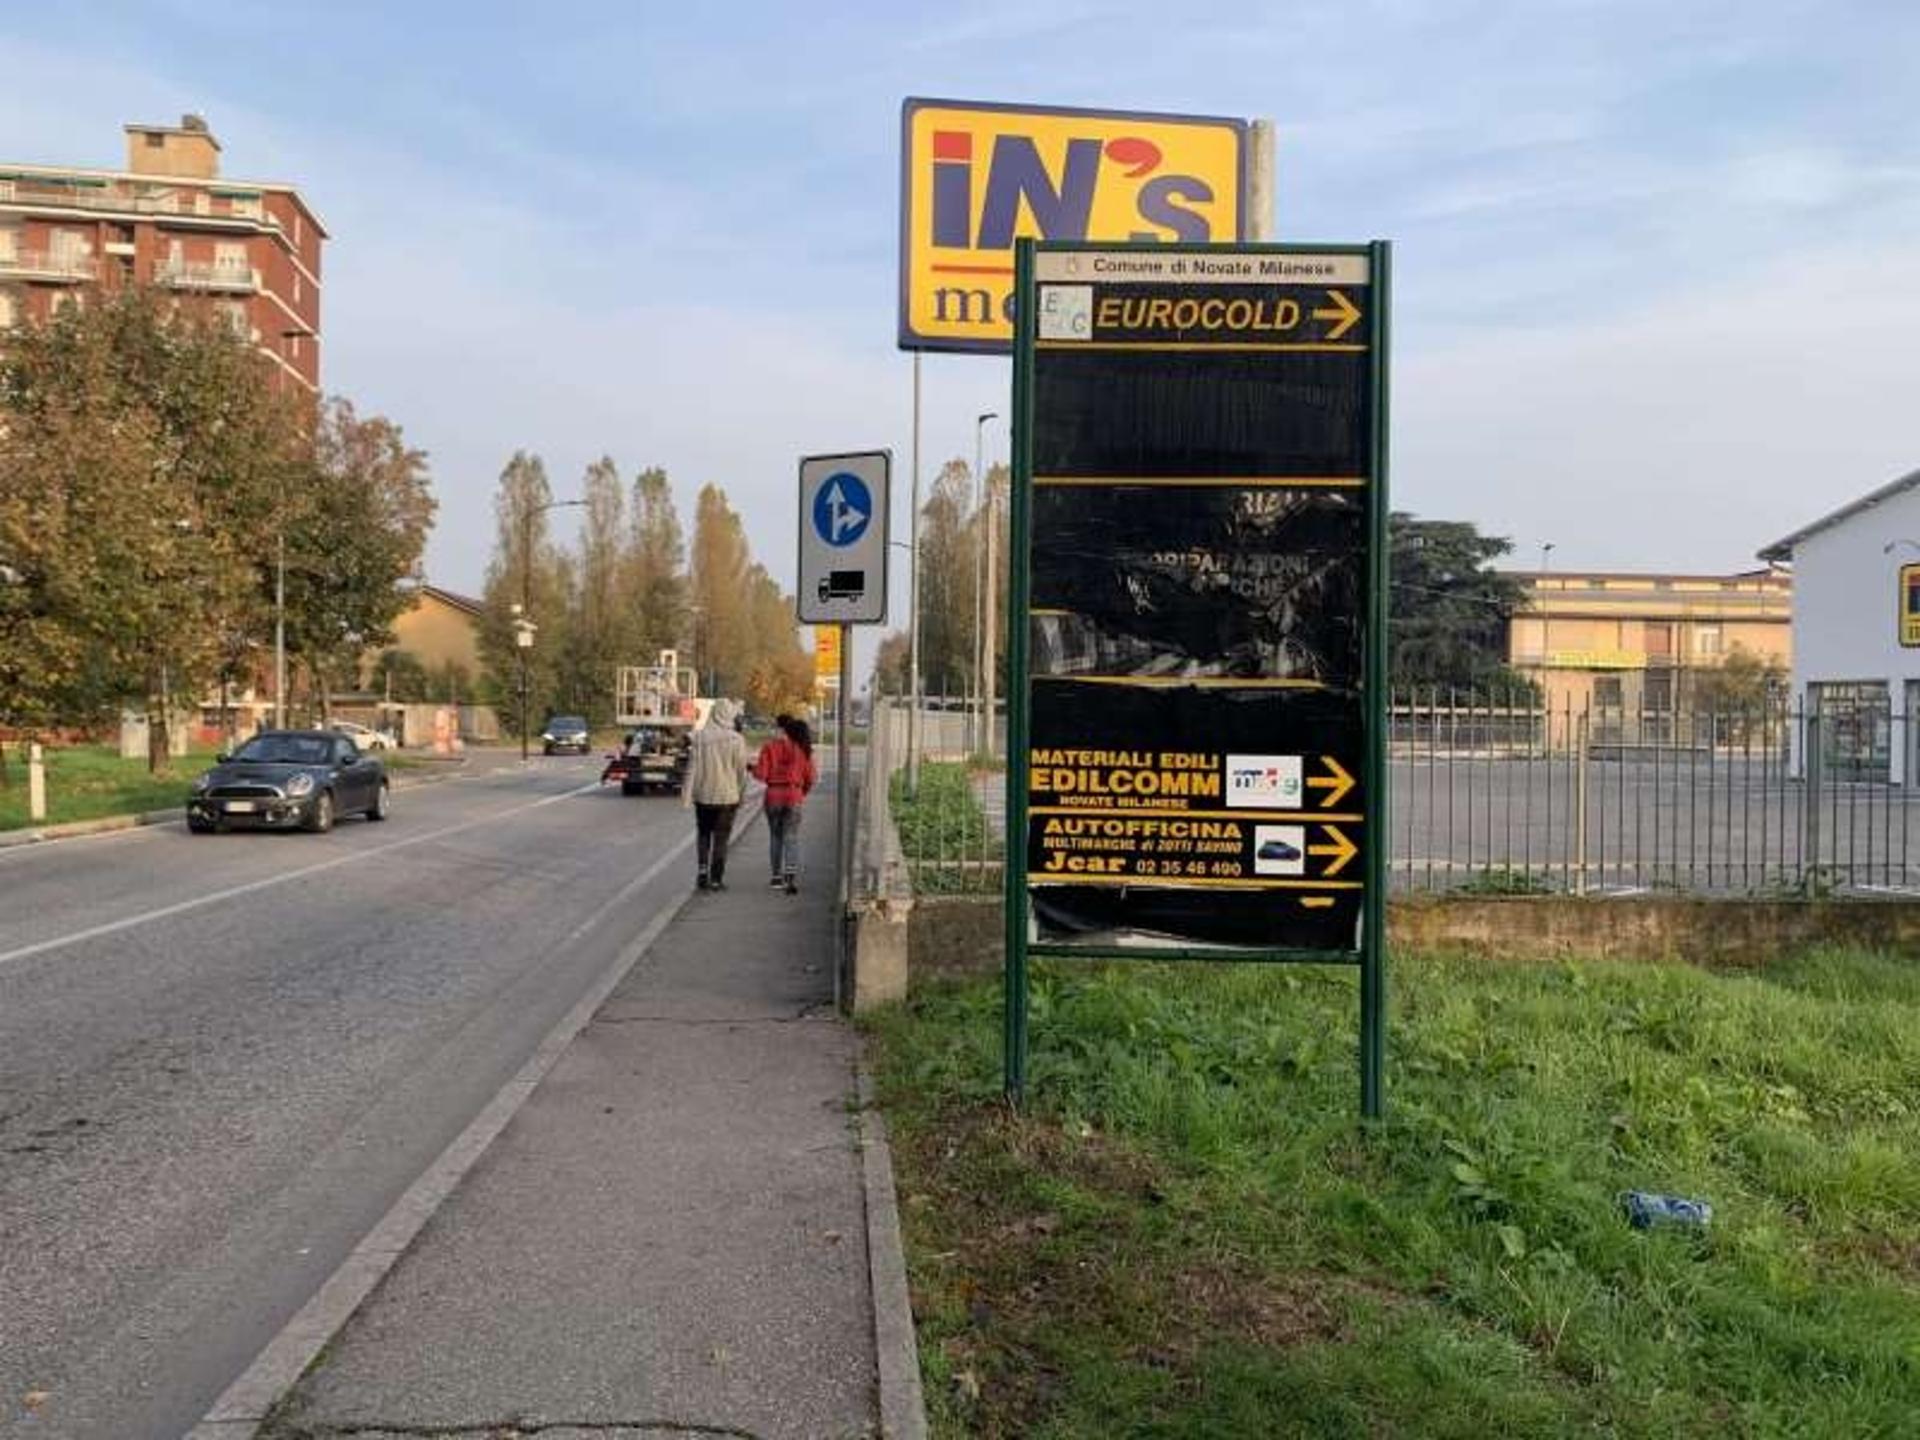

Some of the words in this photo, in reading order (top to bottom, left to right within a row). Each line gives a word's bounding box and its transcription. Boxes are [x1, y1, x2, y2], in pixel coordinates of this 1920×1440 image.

[1094, 258, 1163, 274] Comune
[1170, 258, 1188, 275] di
[1193, 260, 1253, 275] Novate
[1259, 260, 1336, 276] Milanese
[1096, 298, 1300, 331] EUROCOLD
[1031, 749, 1153, 768] MATERIALI
[1159, 753, 1220, 769] EDILI
[1030, 767, 1221, 796] EDILCOMM
[1060, 795, 1114, 807] NOVATE
[1118, 796, 1190, 809] MILANESE
[1043, 817, 1243, 839] AUTOFFICINA
[1042, 836, 1137, 851] MULTIMARCHE
[1043, 851, 1127, 872] Jcar
[1136, 859, 1157, 874] 02
